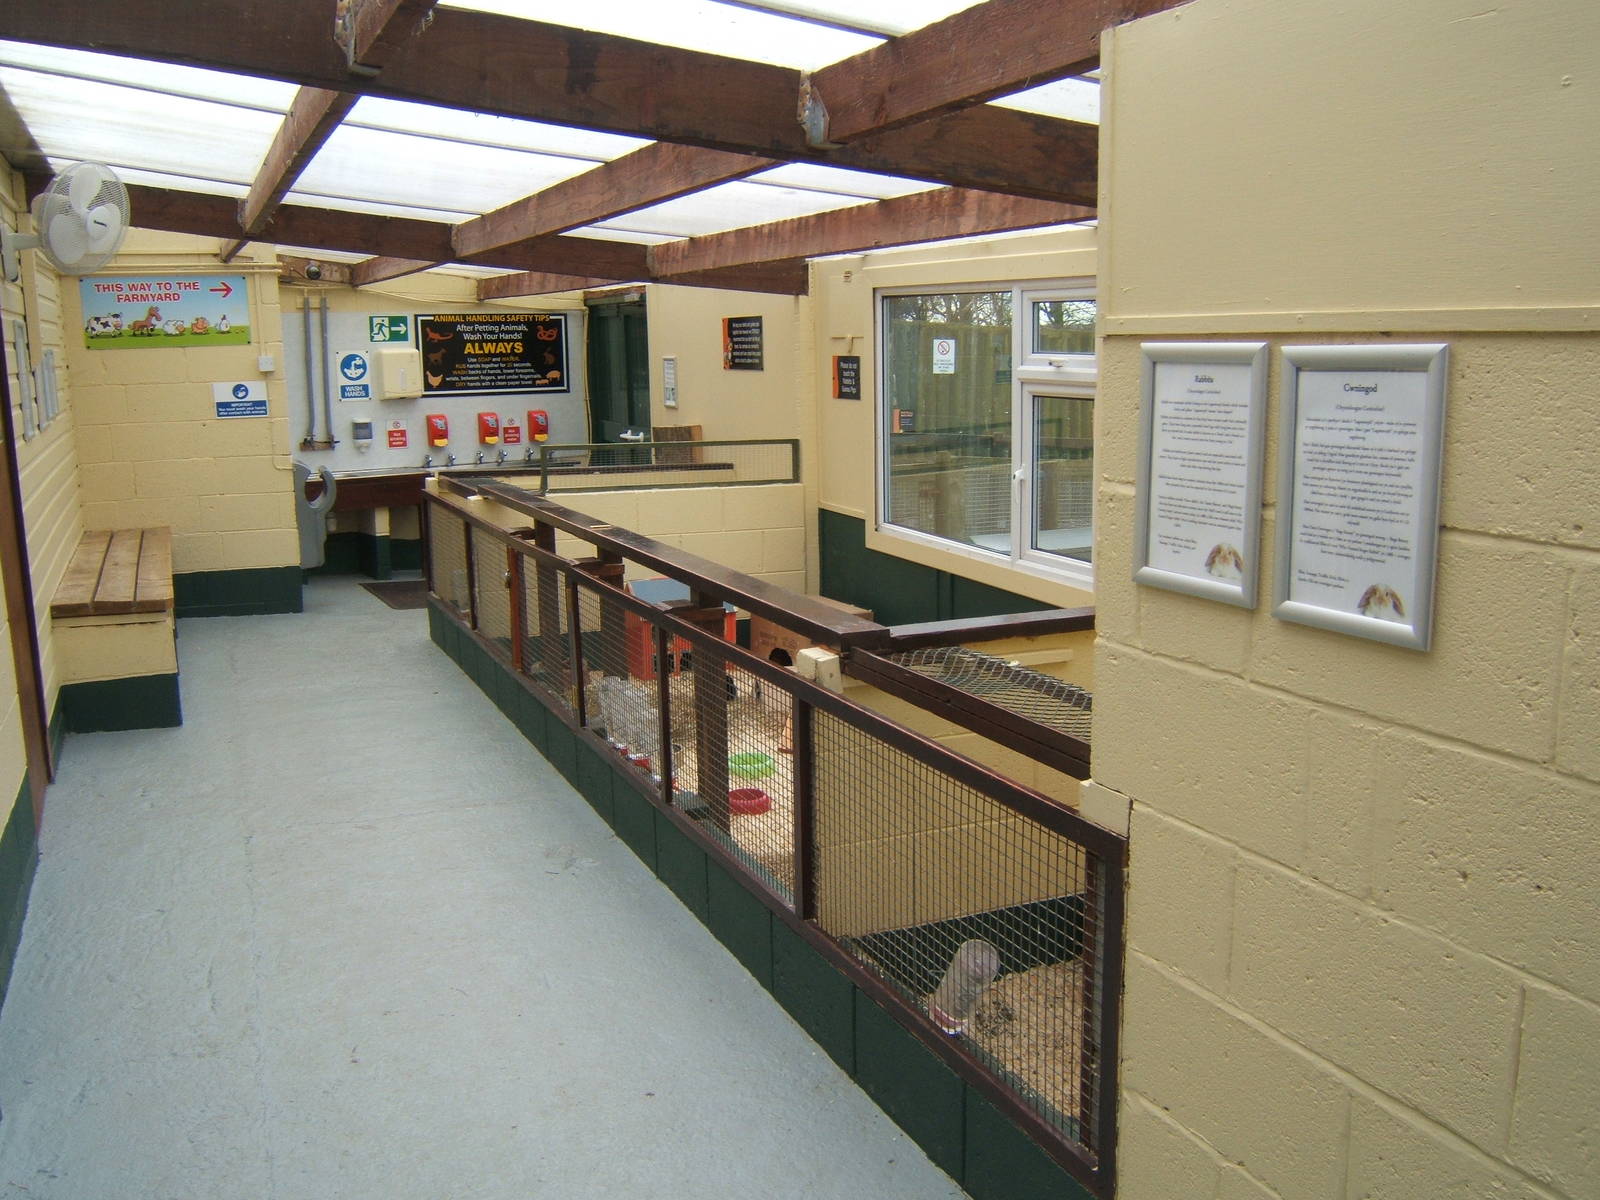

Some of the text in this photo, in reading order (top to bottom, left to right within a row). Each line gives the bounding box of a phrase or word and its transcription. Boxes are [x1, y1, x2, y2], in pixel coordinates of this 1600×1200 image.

[94, 281, 200, 293] THIS WAY TO THE
[116, 292, 181, 303] FARMYARD
[506, 314, 534, 322] SAFETY
[535, 314, 550, 322] TIPS
[456, 324, 528, 333] After Petting Animals,
[499, 332, 522, 340] Hands!
[464, 342, 524, 354] ALWAYS
[1343, 383, 1378, 395] Cwningod
